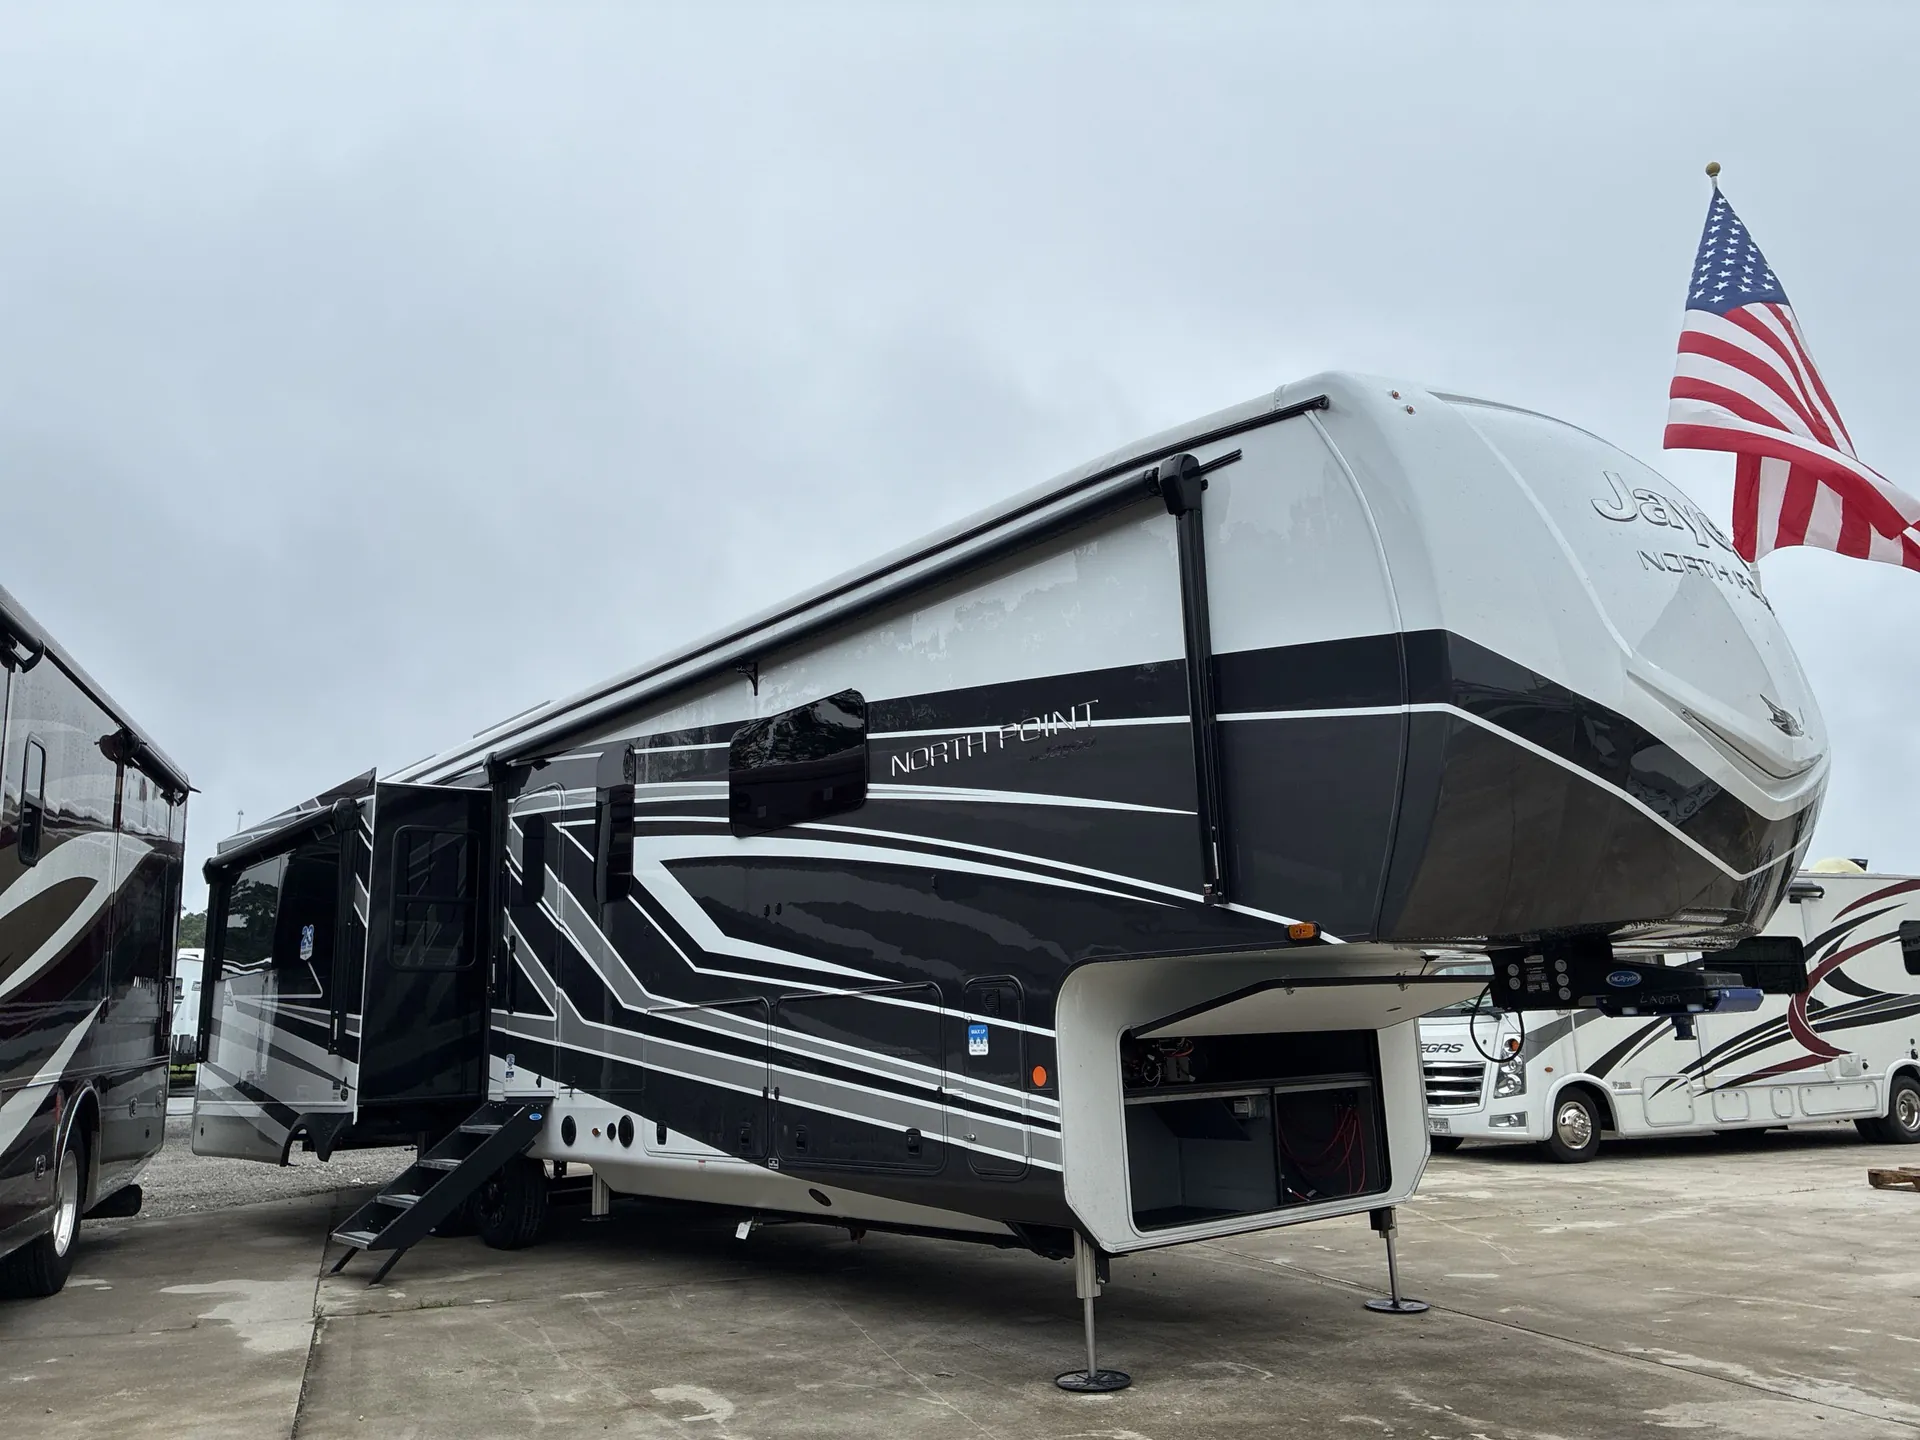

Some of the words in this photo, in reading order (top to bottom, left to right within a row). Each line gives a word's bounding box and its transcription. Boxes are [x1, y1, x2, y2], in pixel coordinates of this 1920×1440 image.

[1591, 471, 1749, 570] Jayc
[1637, 550, 1733, 585] NORTH
[891, 731, 987, 777] NORTH
[1000, 699, 1099, 749] POINT
[1420, 1041, 1464, 1053] EGAS
